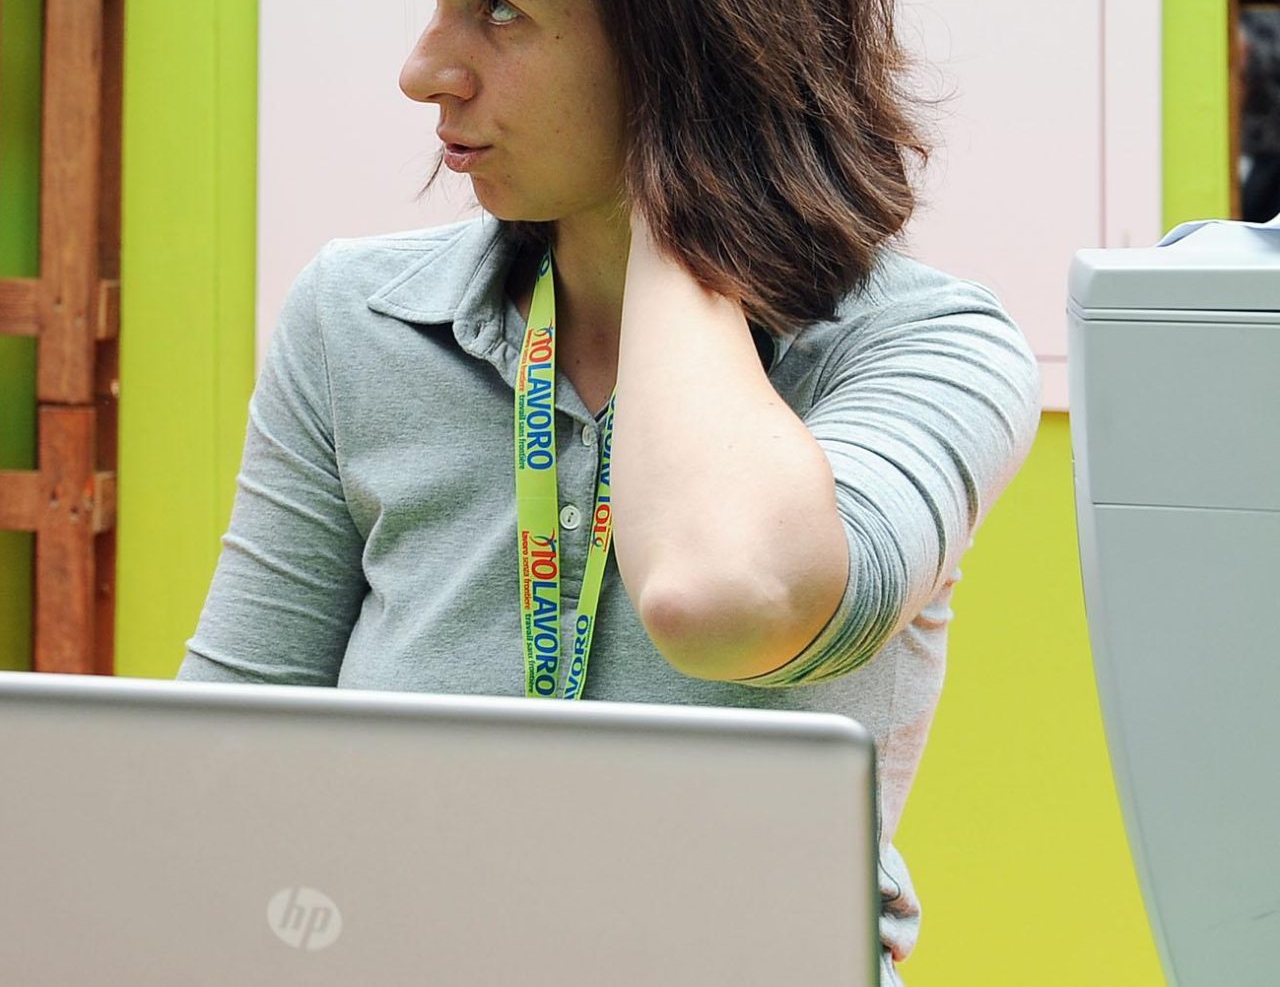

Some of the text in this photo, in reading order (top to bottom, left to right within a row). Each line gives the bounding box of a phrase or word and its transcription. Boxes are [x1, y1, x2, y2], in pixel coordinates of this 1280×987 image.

[518, 395, 526, 420] travail
[521, 531, 529, 555] lavoro
[525, 613, 534, 641] travail
[277, 886, 334, 952] hp
